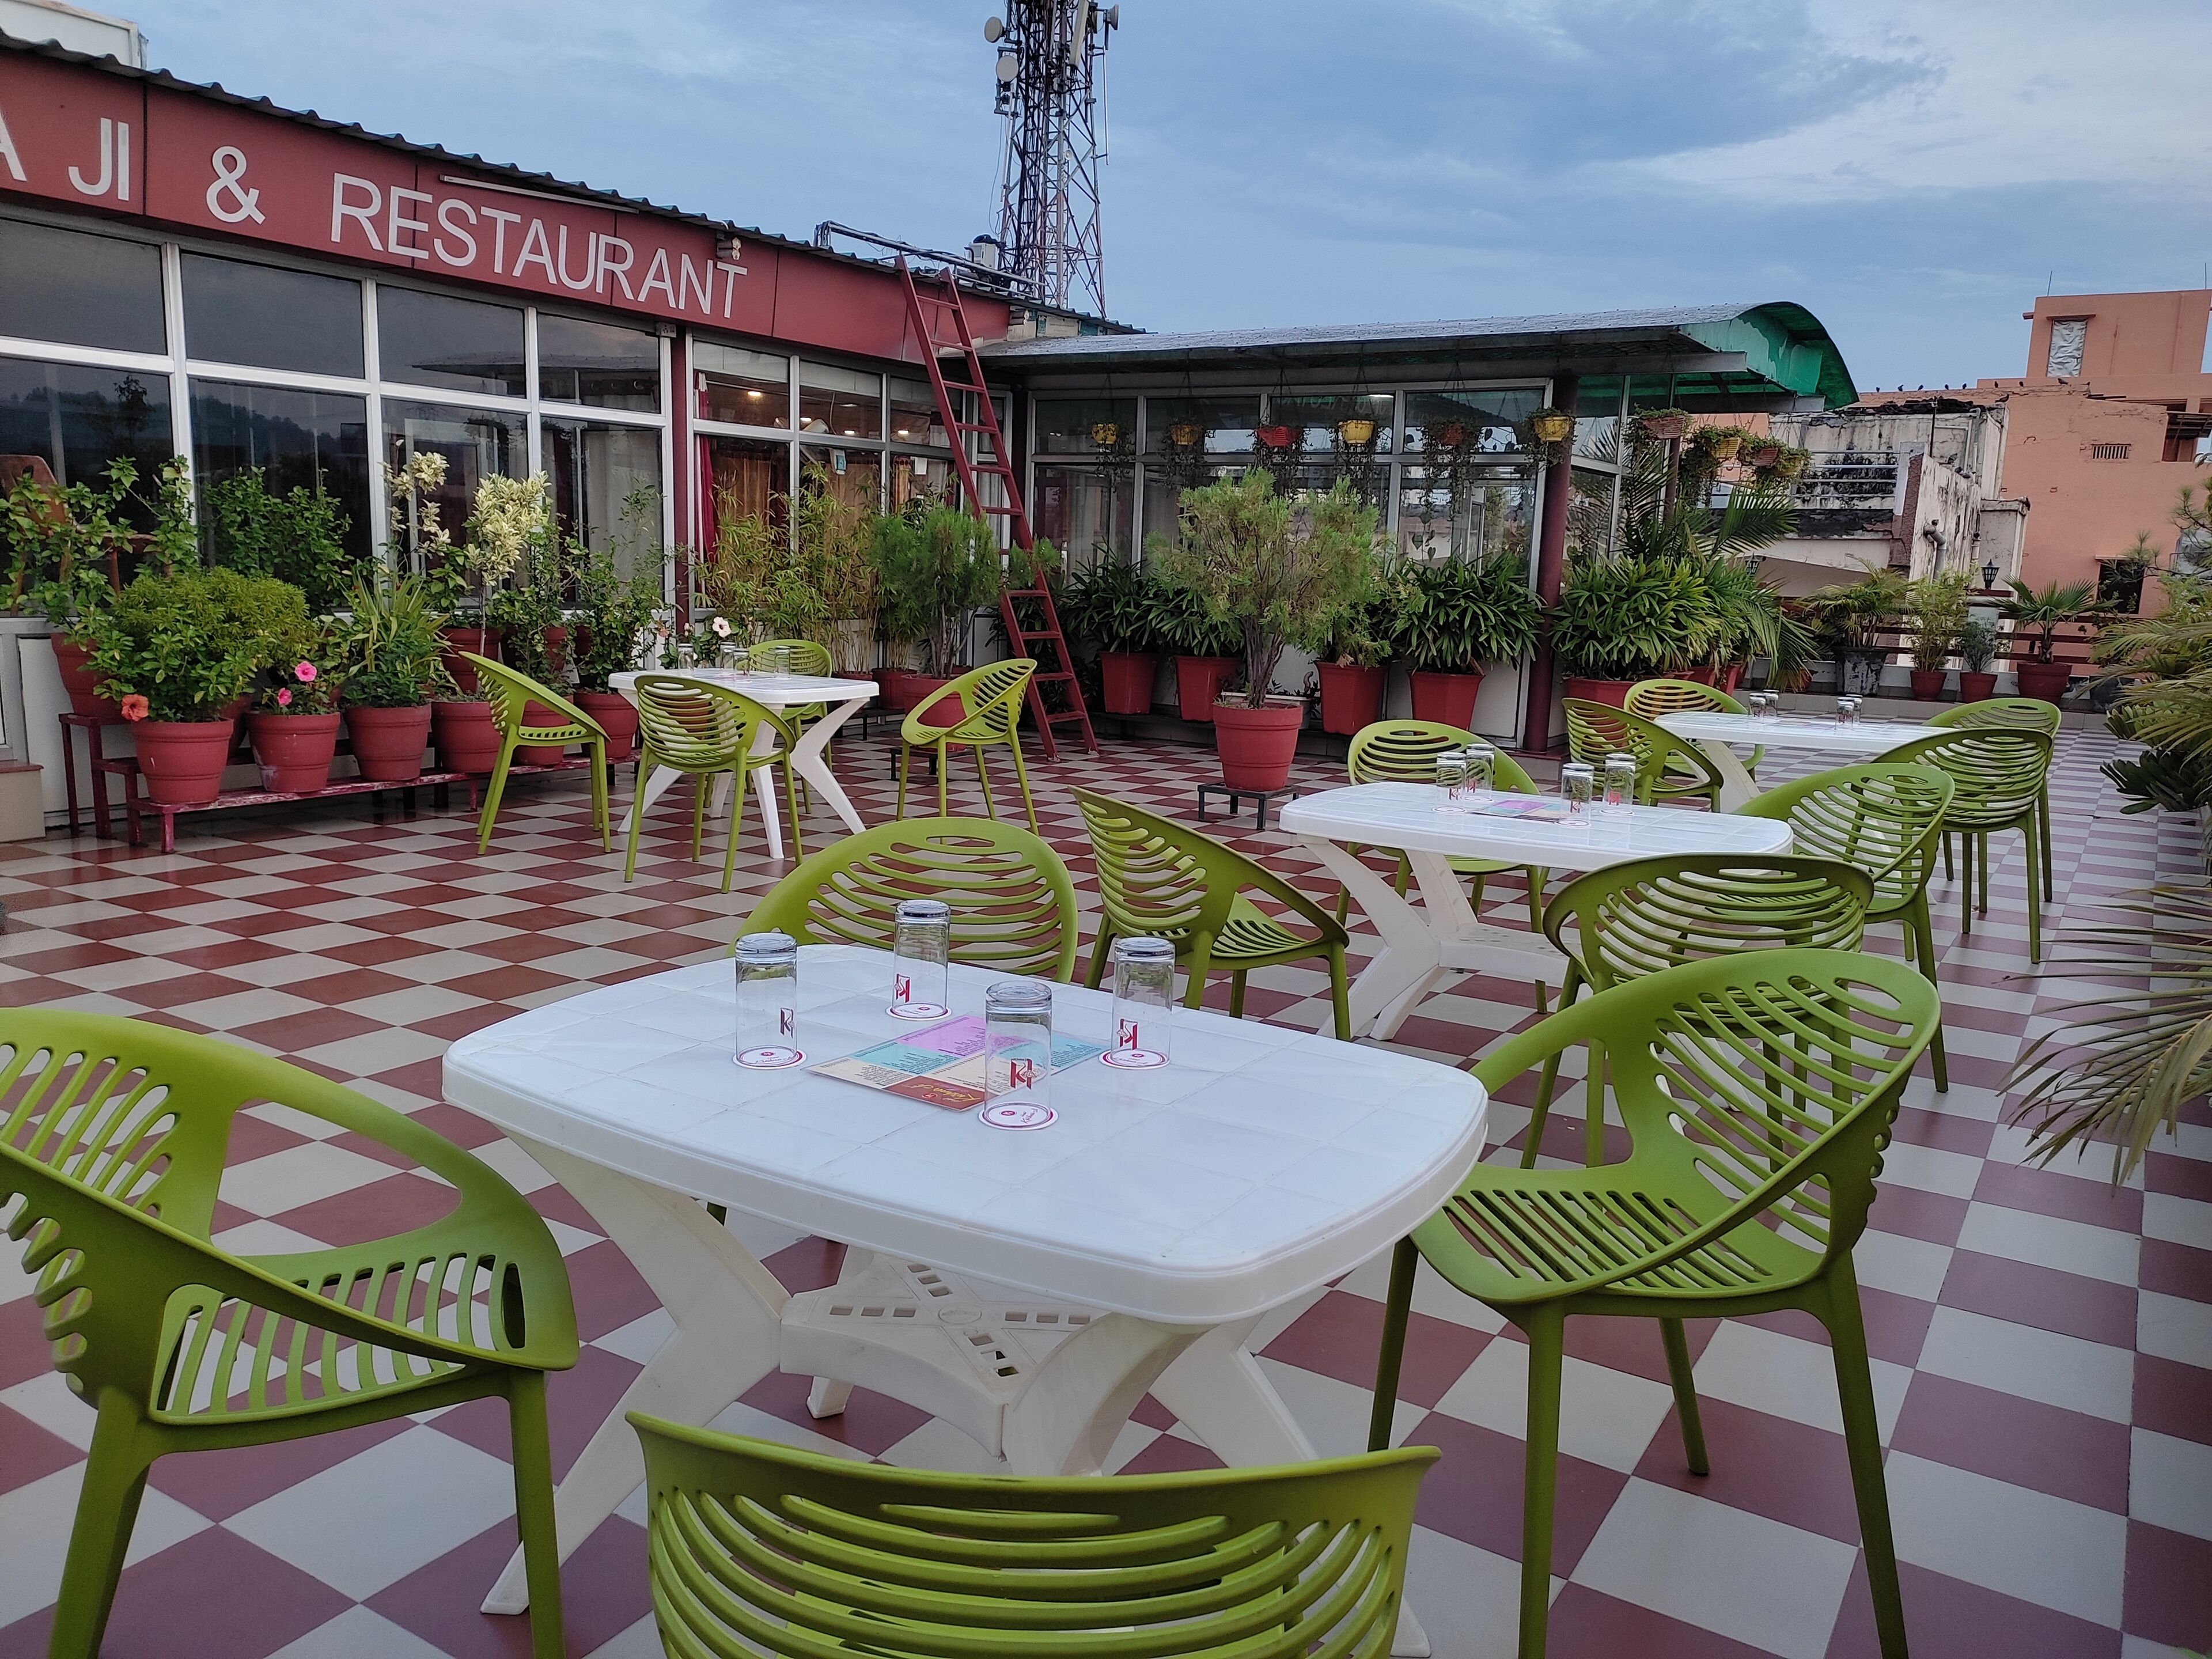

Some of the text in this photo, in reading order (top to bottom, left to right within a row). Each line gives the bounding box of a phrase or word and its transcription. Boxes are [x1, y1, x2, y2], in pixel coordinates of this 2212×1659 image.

[68, 117, 130, 201] JI
[206, 145, 266, 225] &
[330, 172, 748, 319] RESTAURANT
